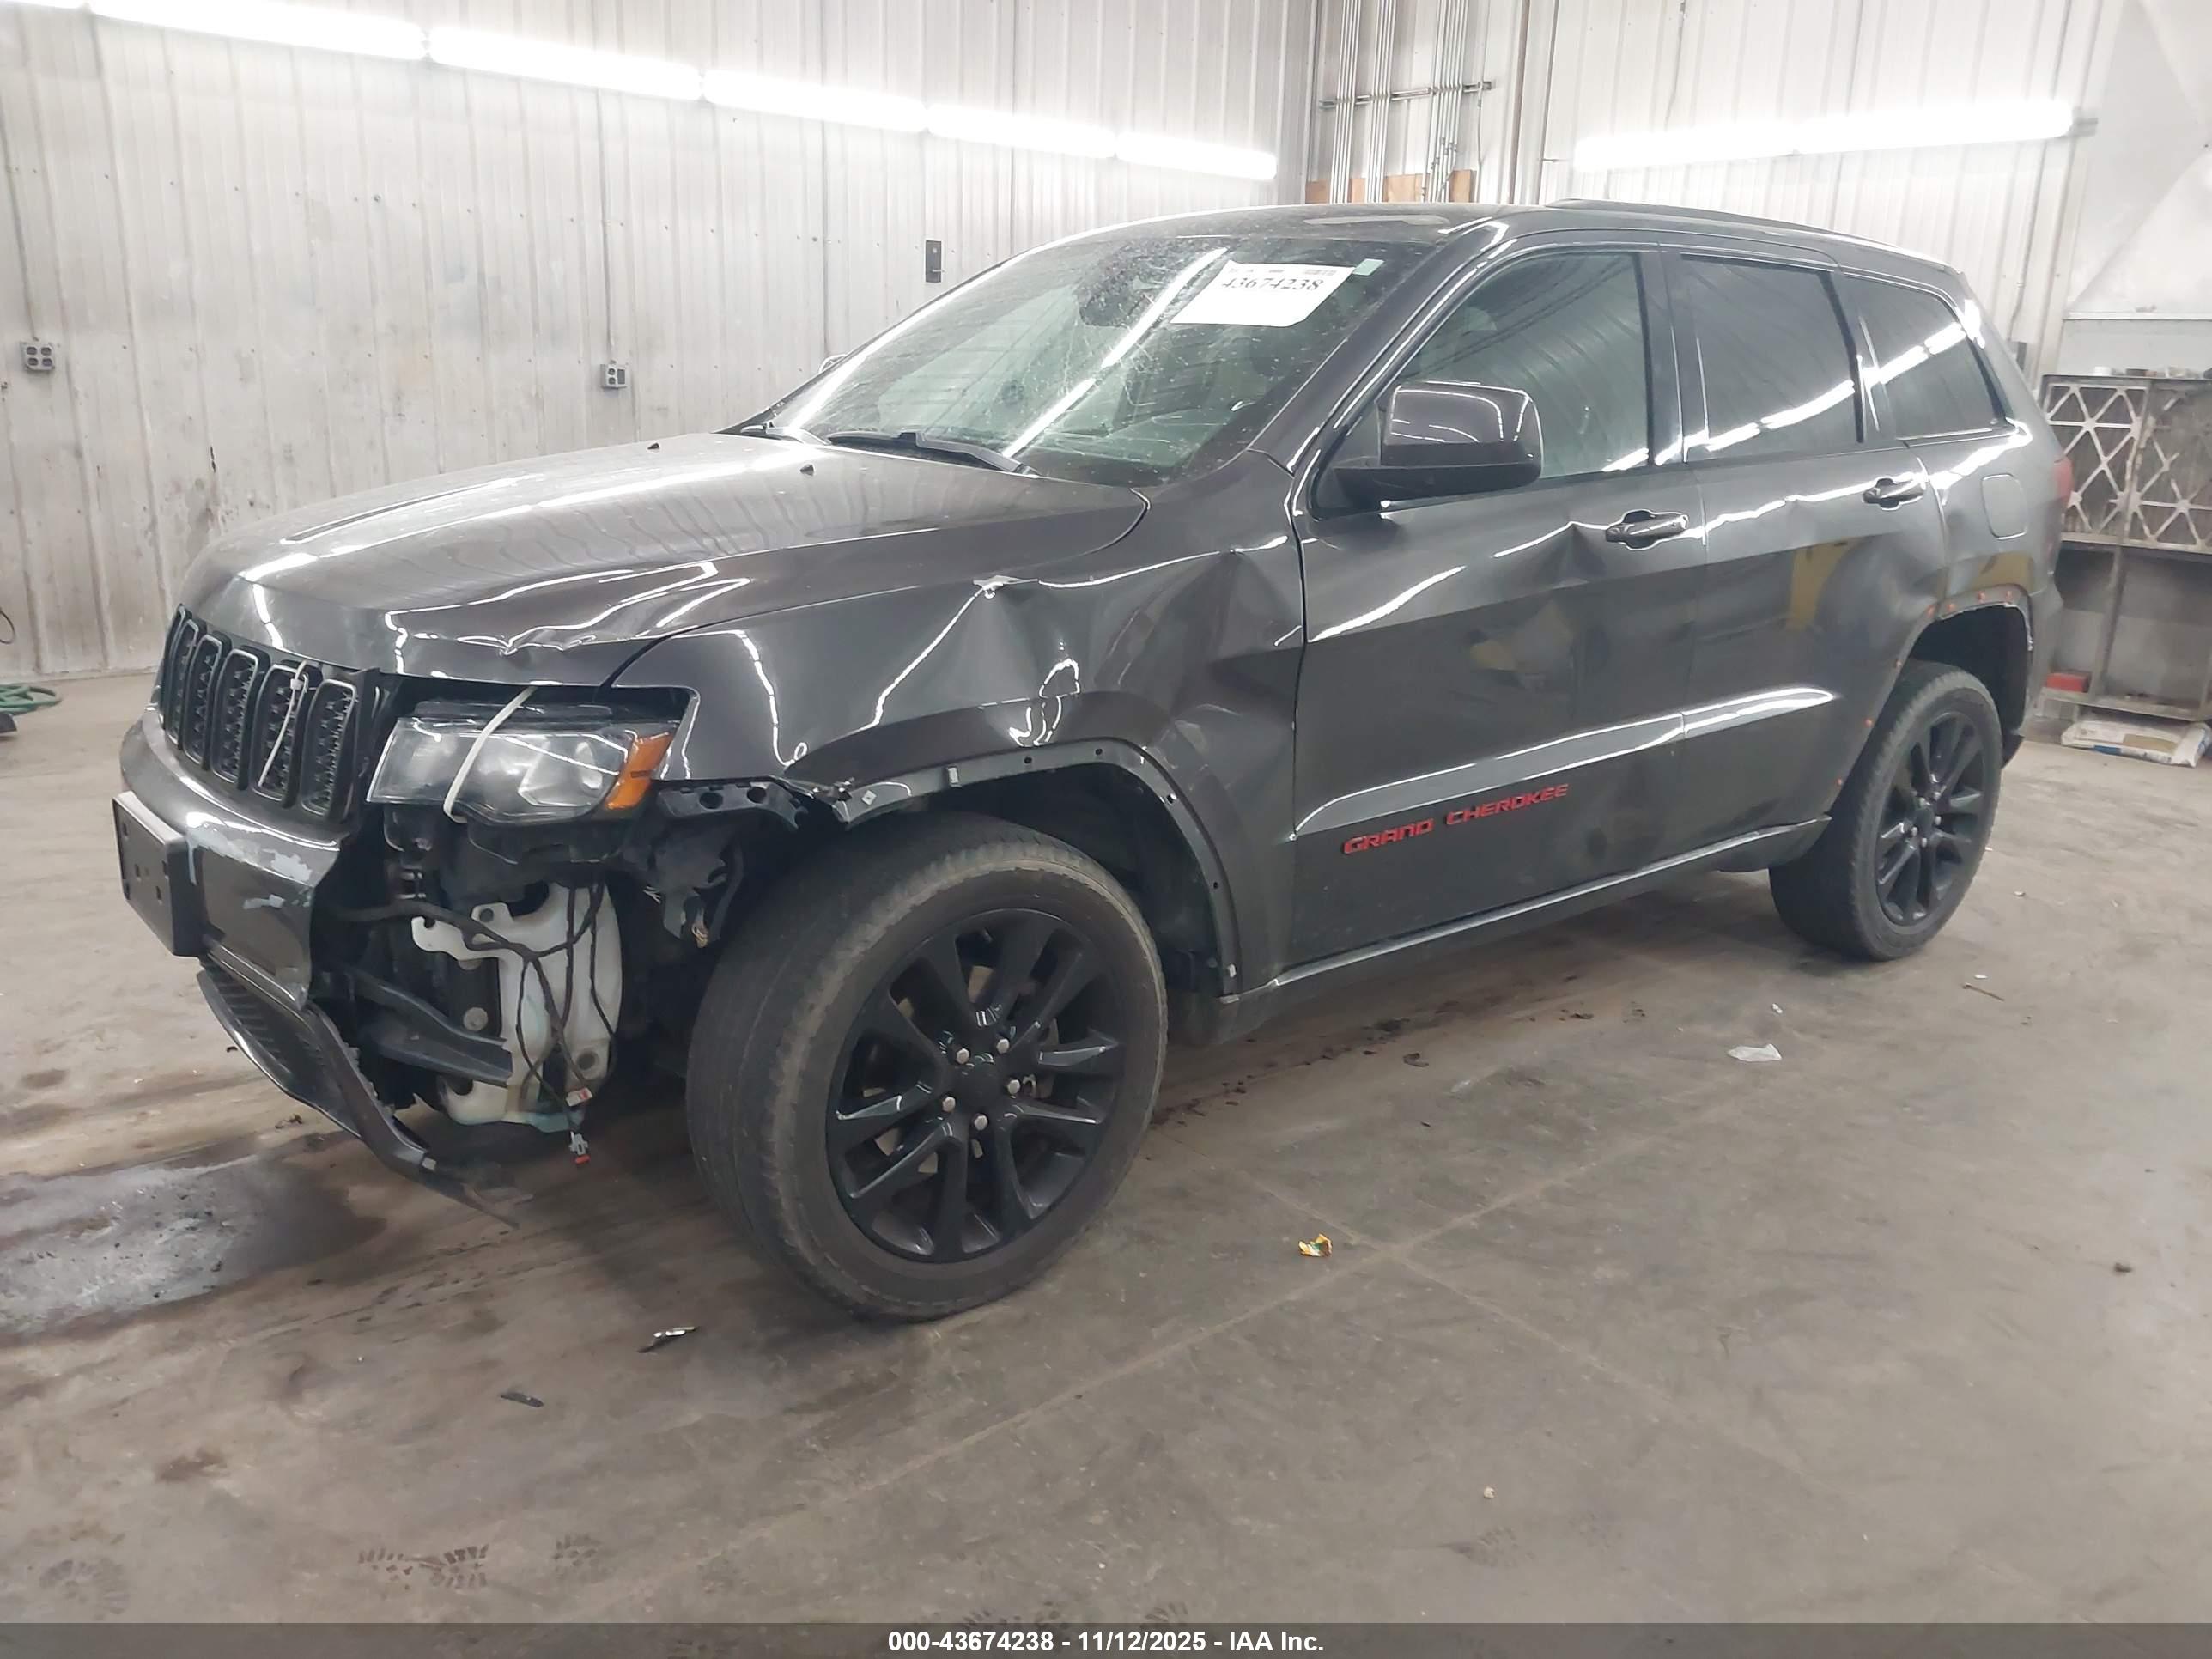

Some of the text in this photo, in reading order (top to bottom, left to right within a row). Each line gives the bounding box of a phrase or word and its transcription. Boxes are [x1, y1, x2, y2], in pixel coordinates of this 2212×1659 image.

[1222, 277, 1325, 291] 43674238
[1342, 783, 1570, 854] GRAND CHEROKEE
